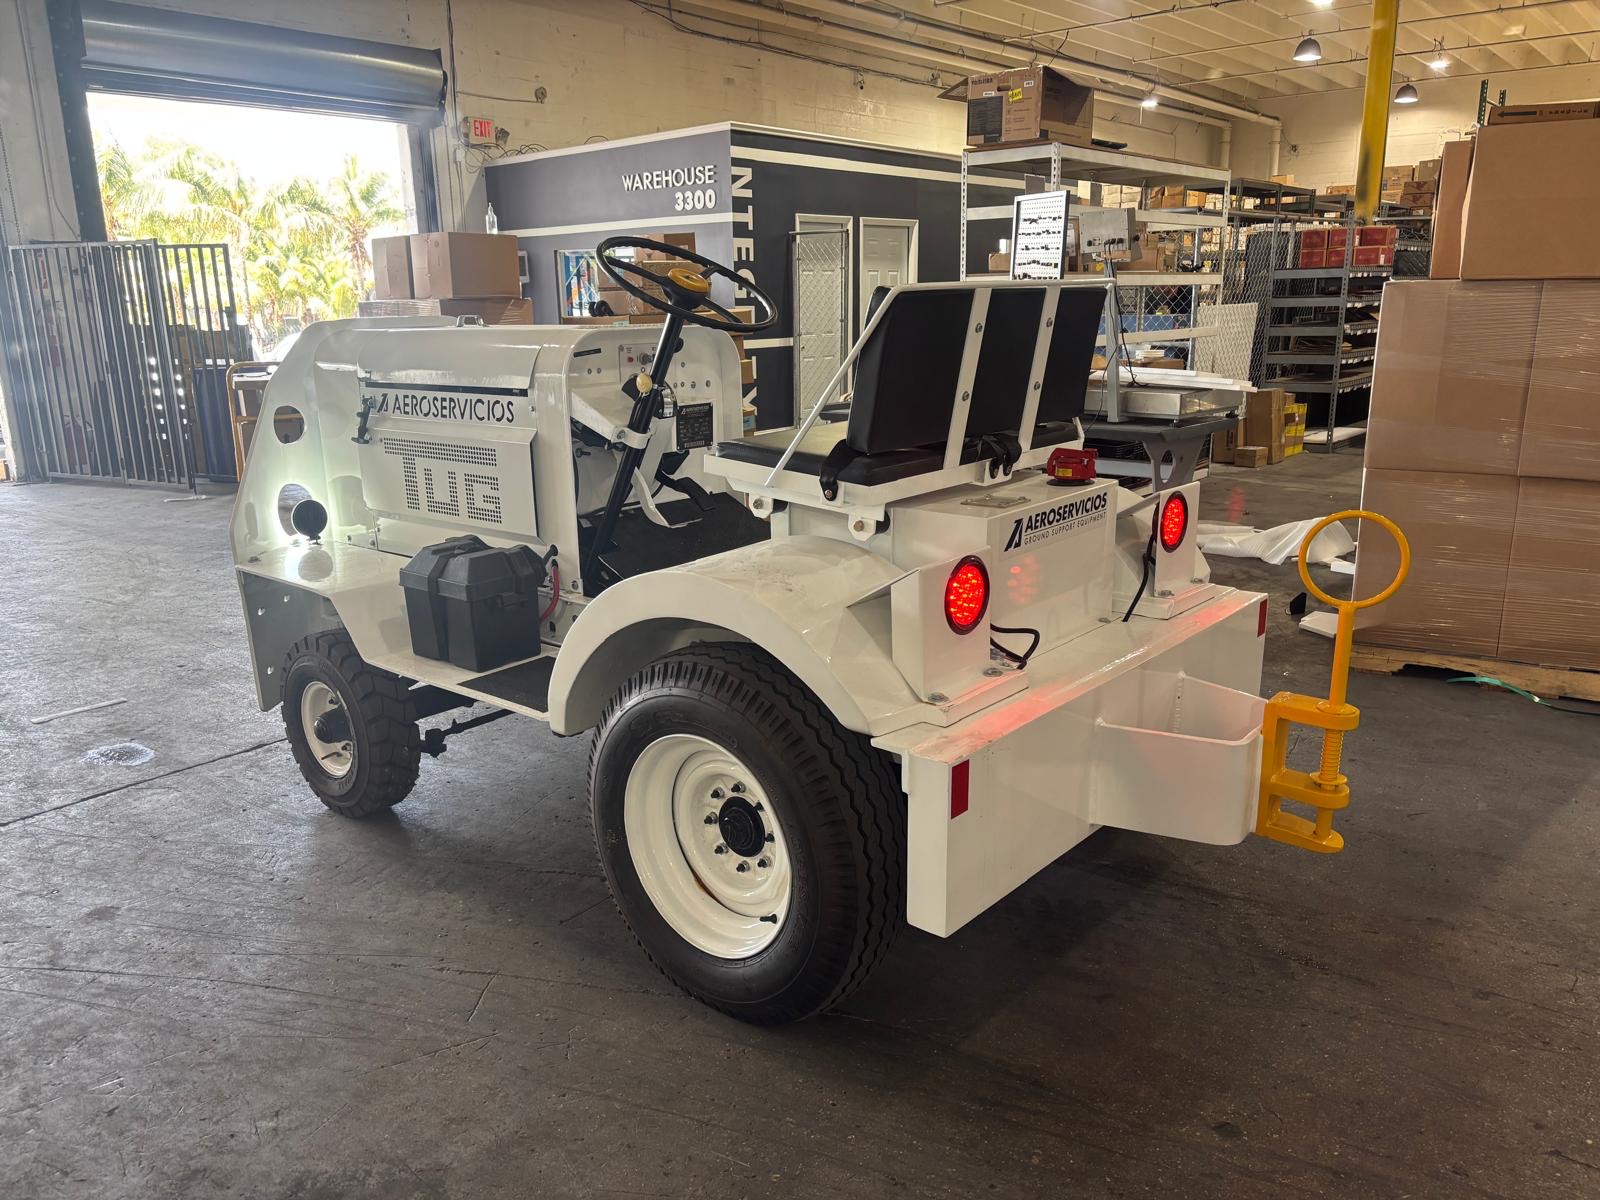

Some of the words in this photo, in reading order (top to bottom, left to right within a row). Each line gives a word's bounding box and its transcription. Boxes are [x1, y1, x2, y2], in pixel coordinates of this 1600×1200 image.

[473, 119, 491, 138] EXIT
[621, 165, 715, 191] WAREHOUSE
[674, 189, 716, 211] 3300
[392, 394, 515, 424] AEROSERVICIOS
[383, 437, 503, 525] TUG
[1024, 492, 1108, 533] AEROSERVICIOS
[1024, 531, 1050, 545] GROUND
[1051, 522, 1076, 536] SUPPORT
[1077, 512, 1106, 527] EQUIPMENT
